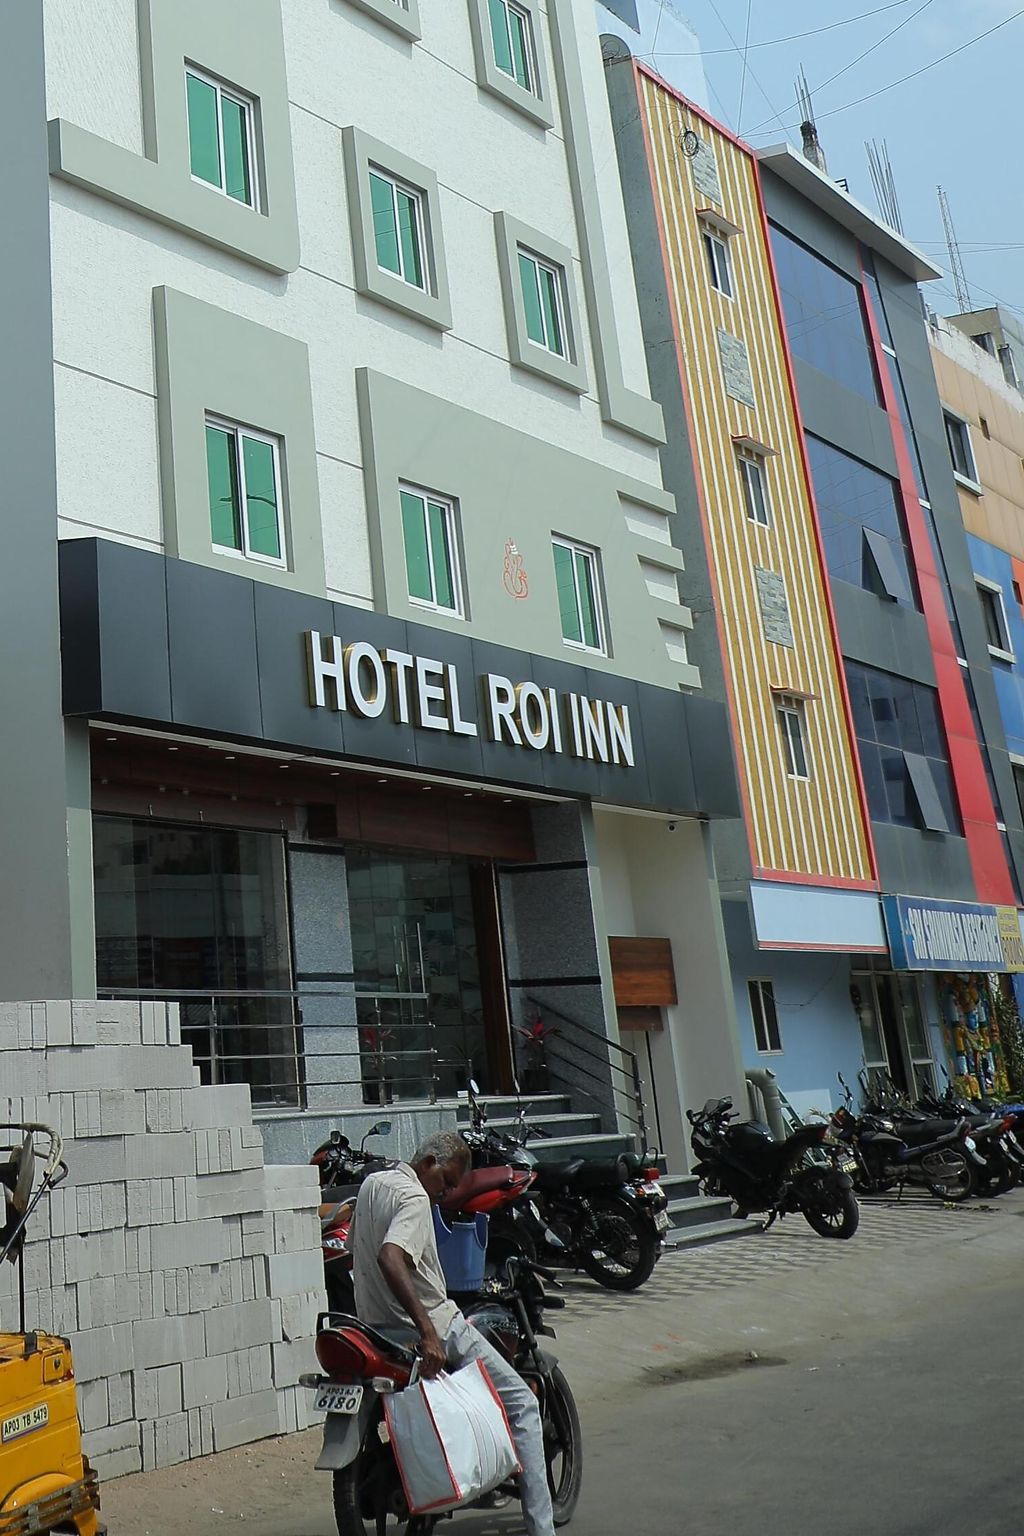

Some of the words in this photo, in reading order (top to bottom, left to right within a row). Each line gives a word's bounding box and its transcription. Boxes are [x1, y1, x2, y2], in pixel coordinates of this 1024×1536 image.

[304, 630, 478, 736] HOTEL
[482, 673, 563, 754] ROI
[564, 692, 635, 767] INN
[908, 907, 929, 960] SRI
[4, 1418, 20, 1435] AP03
[22, 1414, 31, 1427] TB
[33, 1406, 47, 1423] 5479
[318, 1395, 356, 1410] 6180
